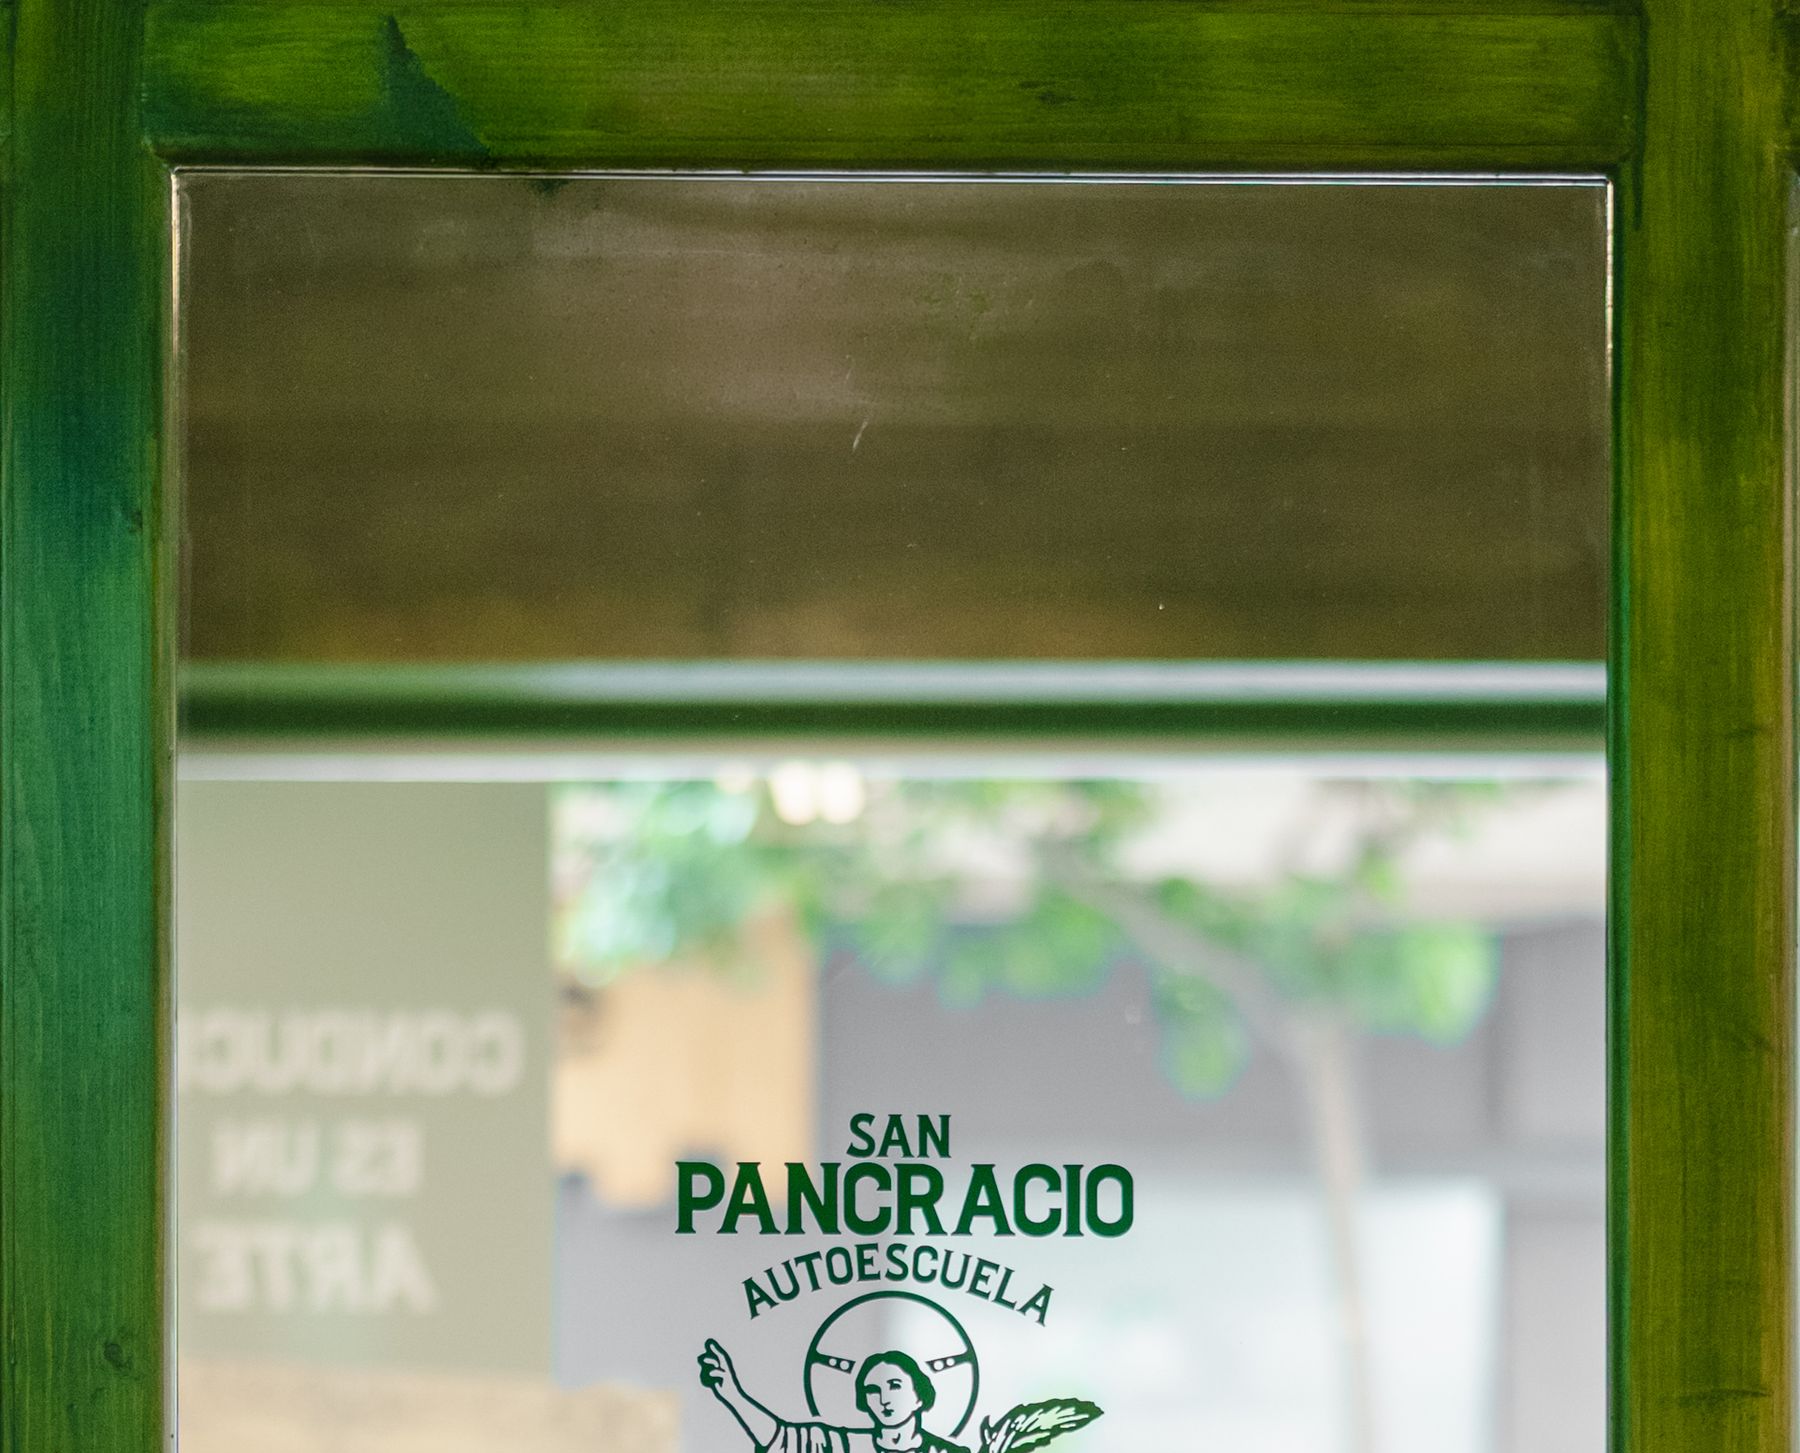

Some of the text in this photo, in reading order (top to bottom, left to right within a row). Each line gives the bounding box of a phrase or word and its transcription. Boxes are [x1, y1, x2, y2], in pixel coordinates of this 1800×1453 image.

[847, 1113, 951, 1158] SAN
[674, 1161, 1134, 1237] PANCRACIO
[741, 1242, 1055, 1327] AUTOESCUELA
